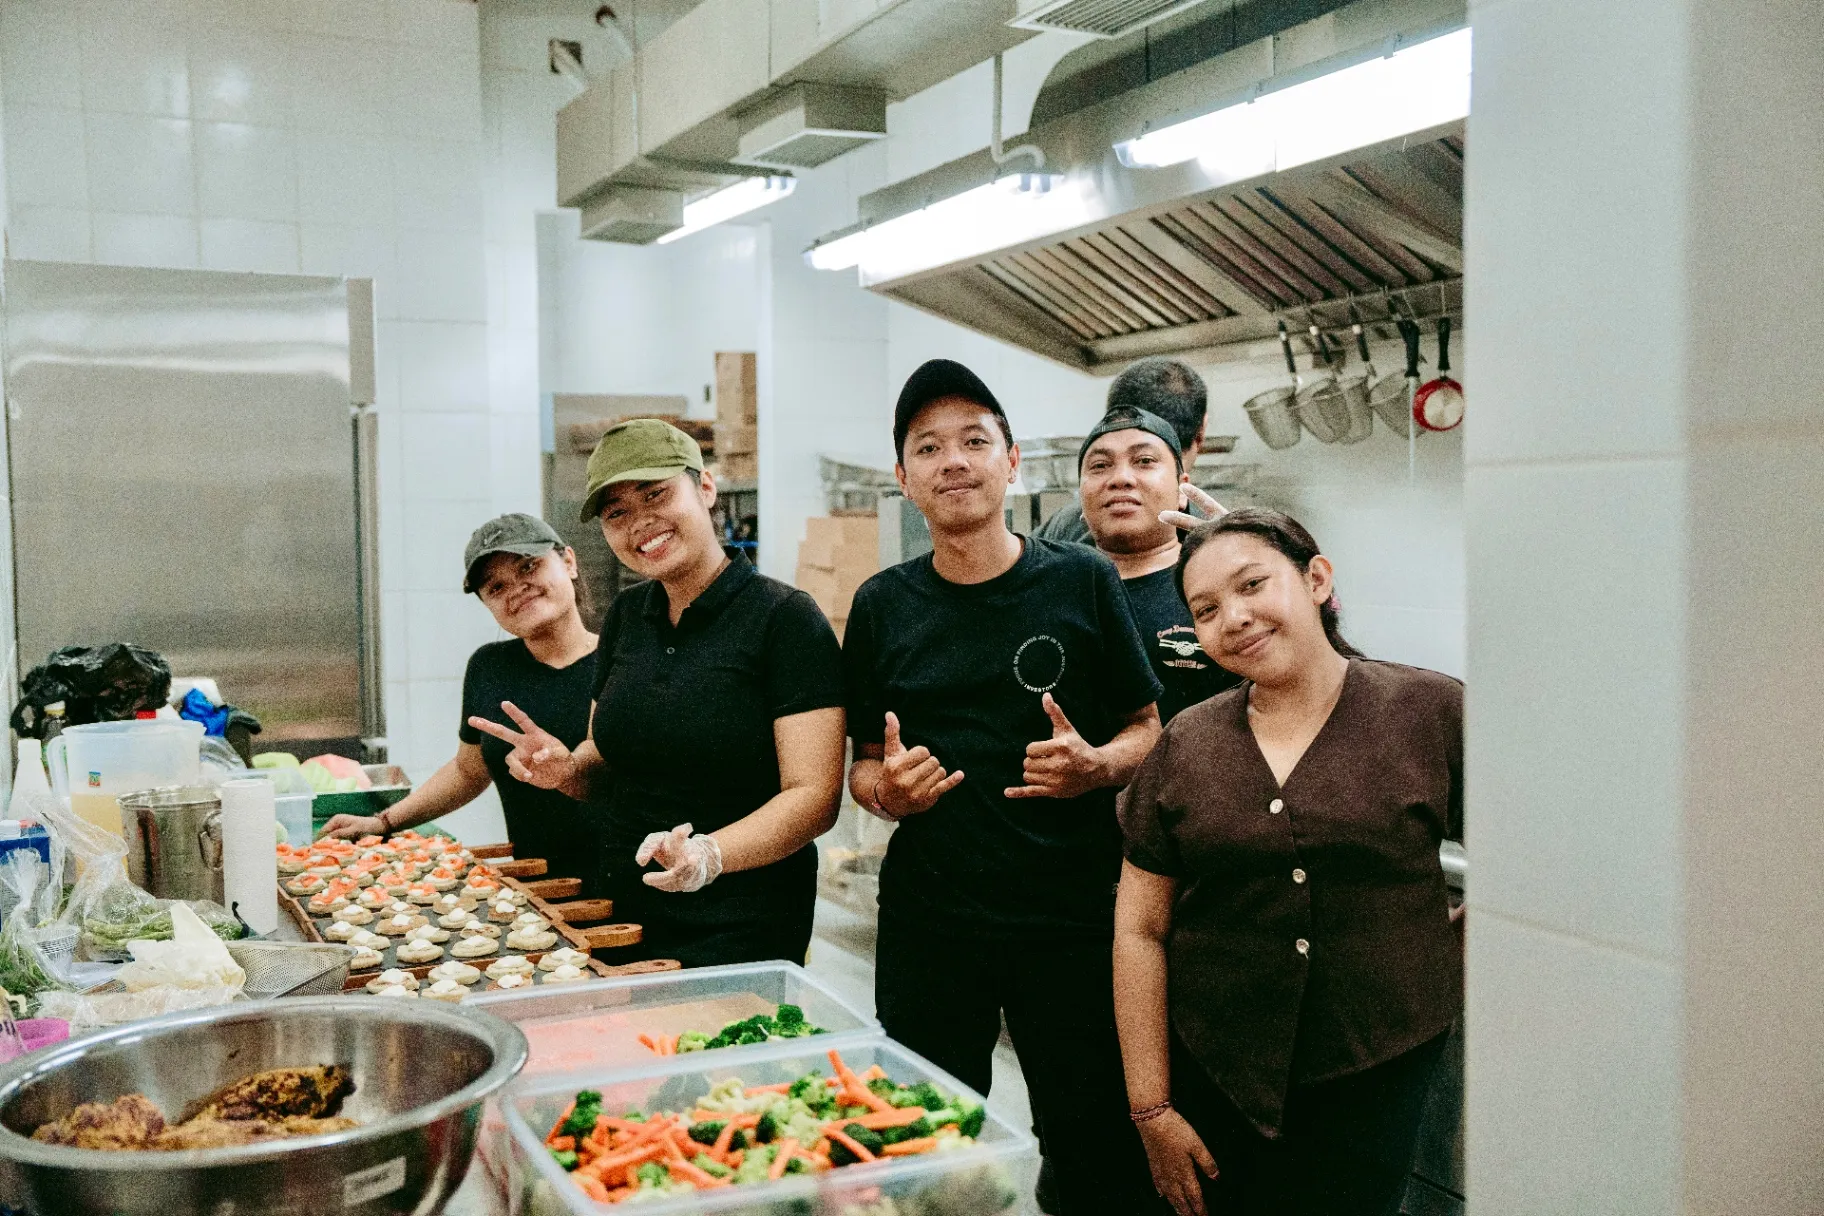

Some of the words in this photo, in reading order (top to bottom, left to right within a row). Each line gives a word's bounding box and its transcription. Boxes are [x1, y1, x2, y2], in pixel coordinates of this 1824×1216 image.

[1016, 636, 1037, 655] FINDING
[1056, 642, 1065, 654] THE
[1024, 683, 1057, 692] INVESTORS
